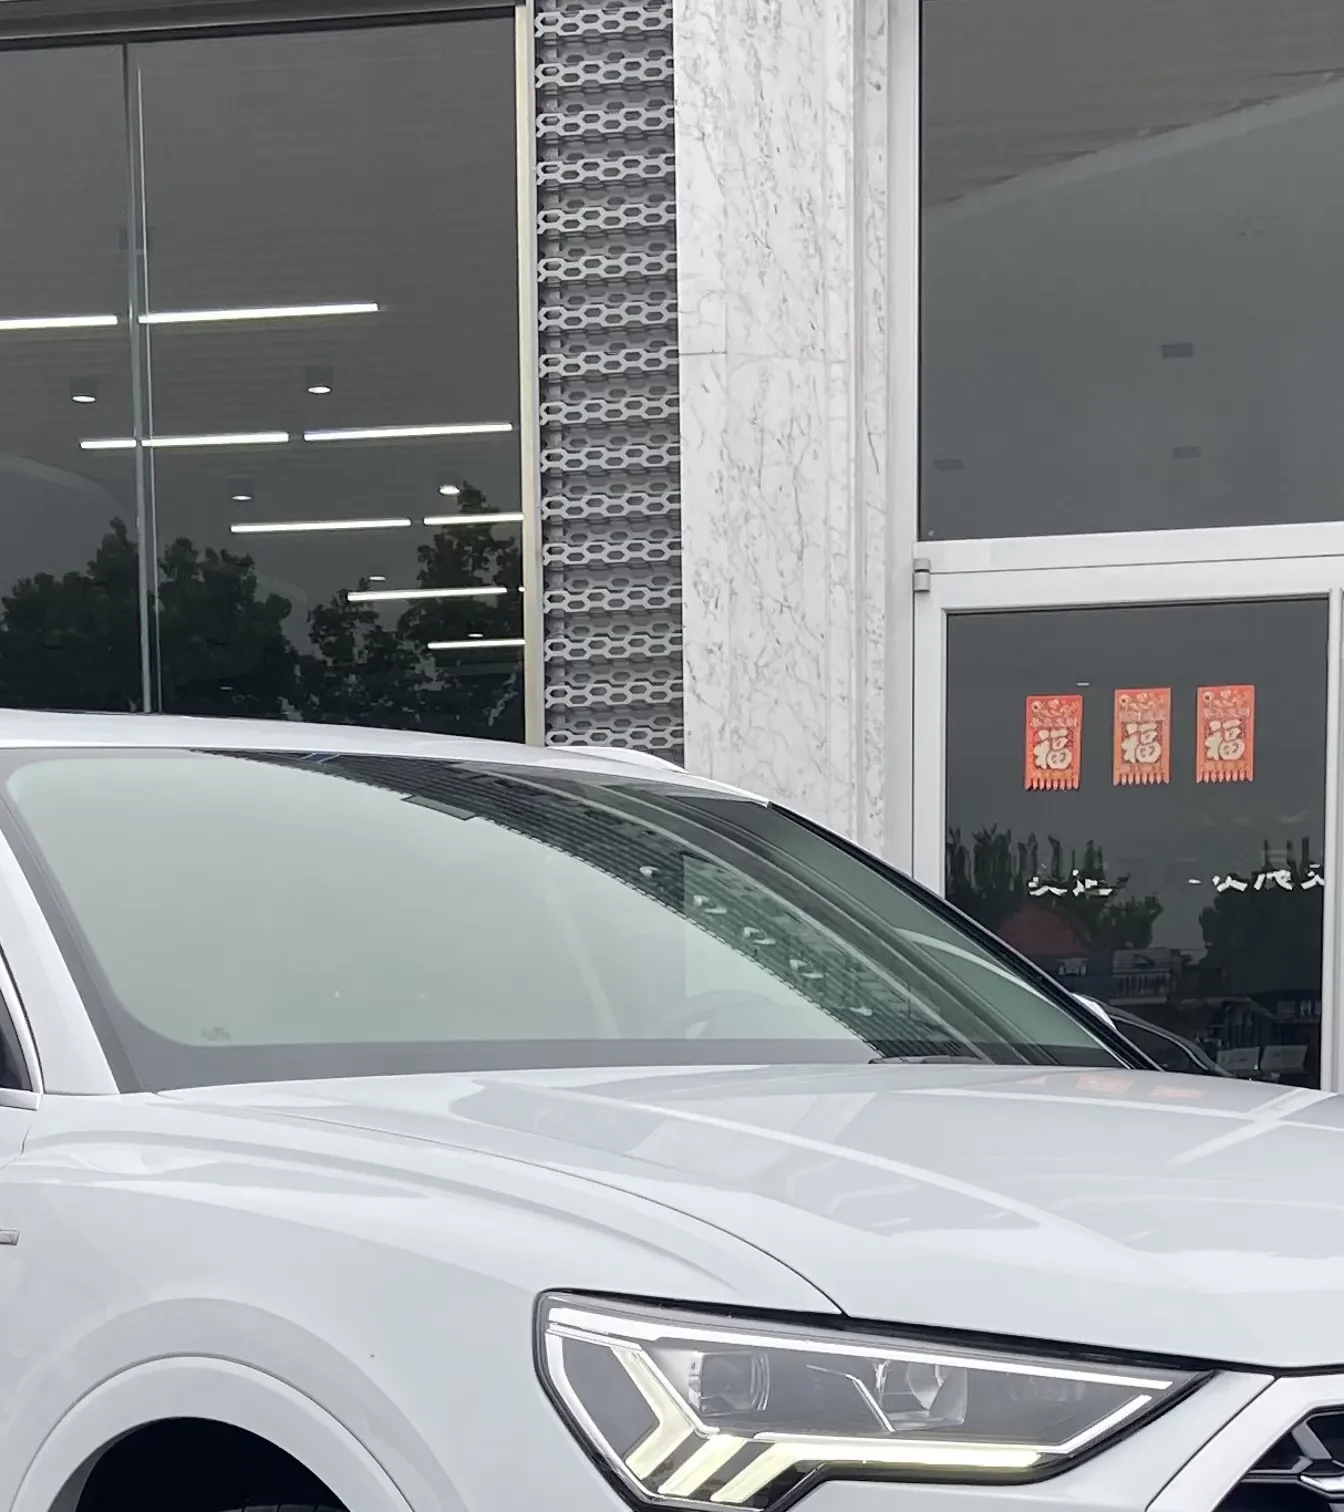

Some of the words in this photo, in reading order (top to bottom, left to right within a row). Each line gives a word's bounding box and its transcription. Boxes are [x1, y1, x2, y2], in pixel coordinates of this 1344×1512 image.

[1033, 727, 1072, 770] 福
[1121, 723, 1161, 764] 福
[1204, 720, 1245, 761] 福
